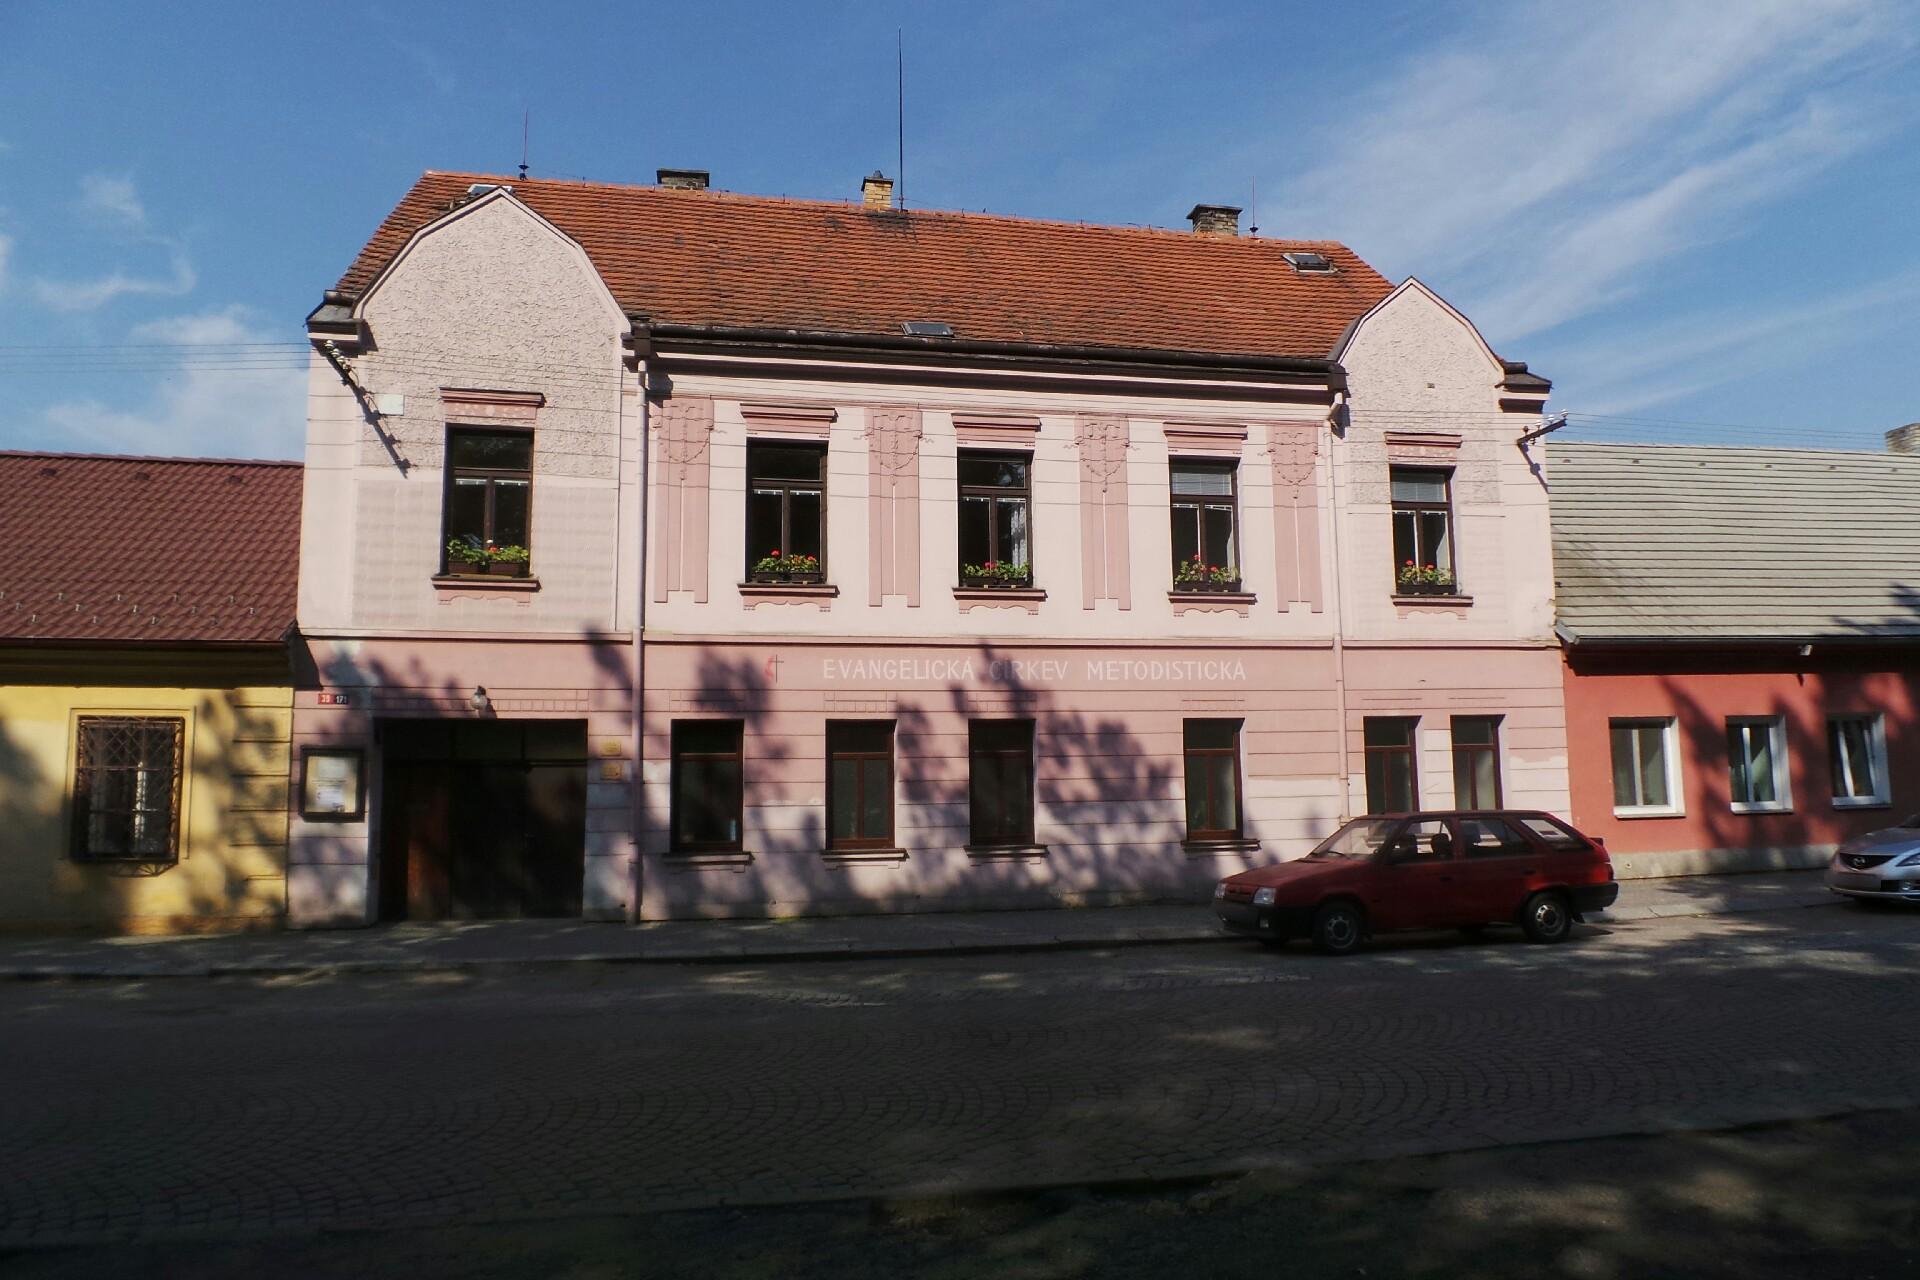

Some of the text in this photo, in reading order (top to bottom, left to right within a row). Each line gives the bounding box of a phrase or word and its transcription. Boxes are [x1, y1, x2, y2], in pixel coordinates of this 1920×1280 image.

[823, 656, 1248, 681] EVANGELICKÁ CÍRKEV METODISTICKÁ
